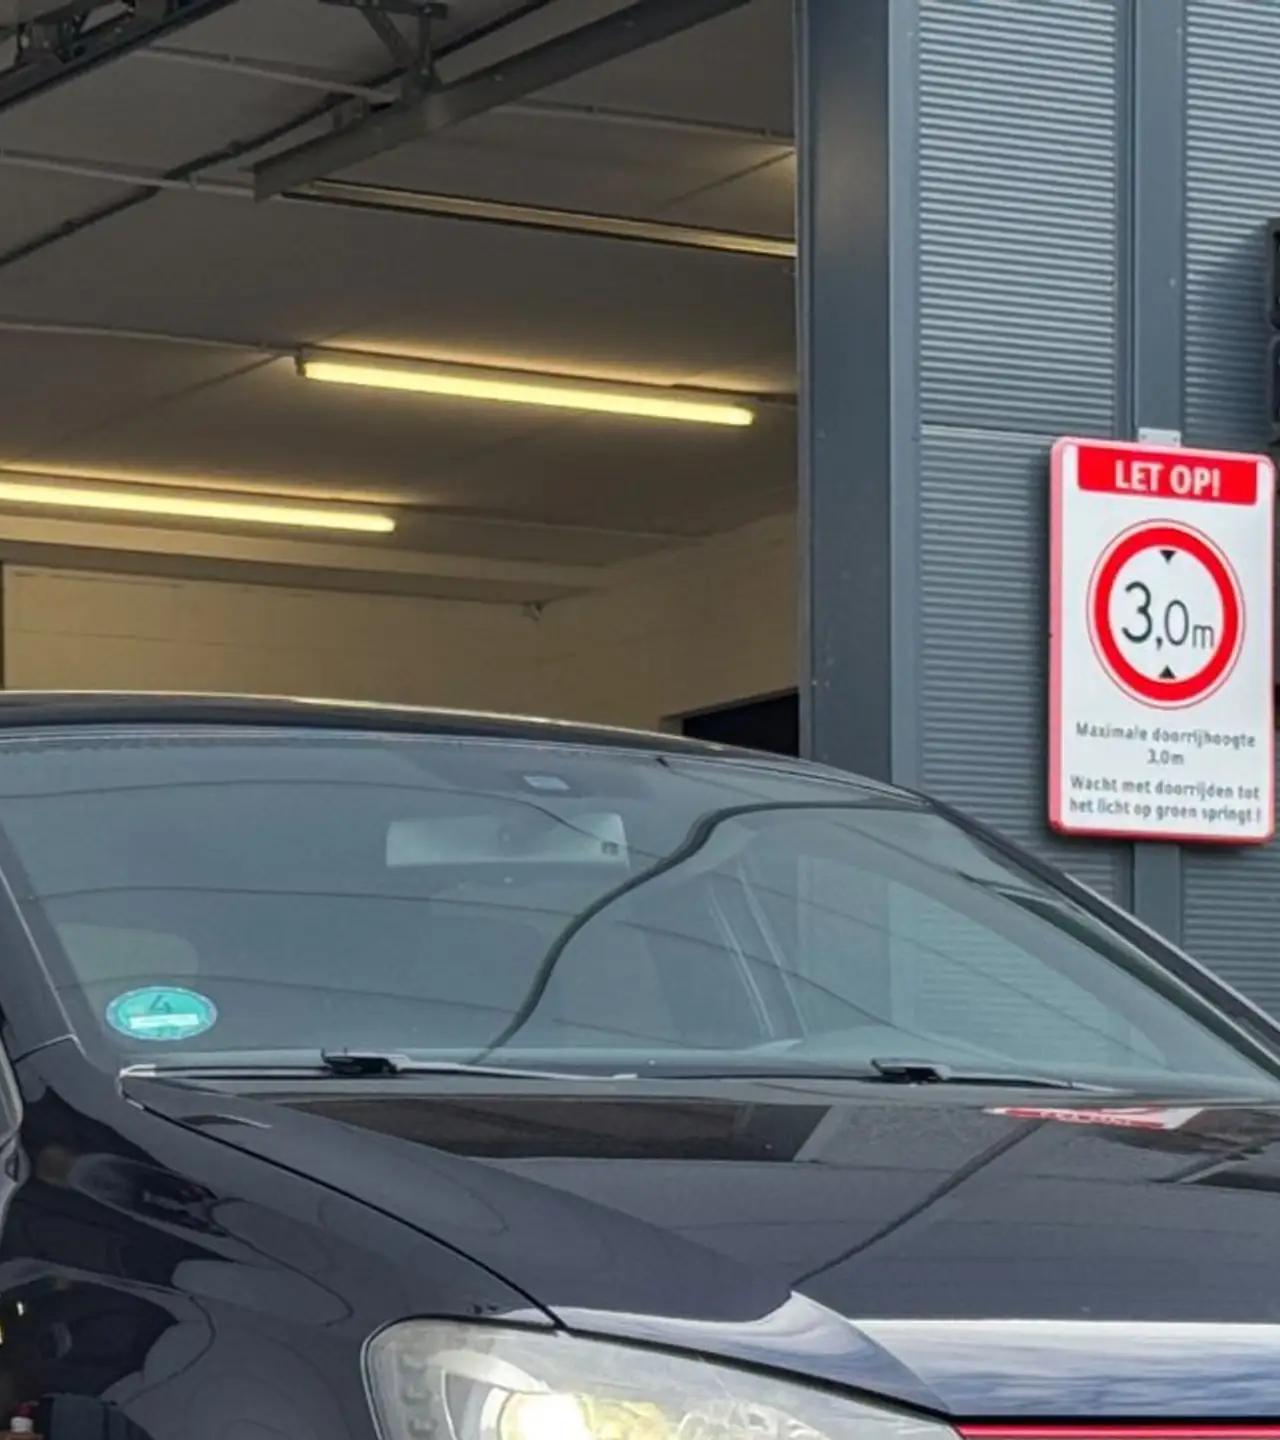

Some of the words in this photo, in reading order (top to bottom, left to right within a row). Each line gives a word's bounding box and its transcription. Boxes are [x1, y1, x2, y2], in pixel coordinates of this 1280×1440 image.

[1115, 459, 1163, 493] LET
[1170, 464, 1221, 497] OP!
[1122, 580, 1215, 651] 3,0m
[1076, 722, 1148, 741] Maximale
[1152, 728, 1256, 750] doorrijhoogte
[1070, 773, 1118, 794] Wacht
[1122, 779, 1152, 795] met
[1155, 779, 1234, 802] doorrijden
[1238, 785, 1260, 800] tot
[1069, 797, 1094, 813] het
[1097, 798, 1130, 815] licht
[1134, 804, 1152, 819] op
[1156, 805, 1198, 821] groen
